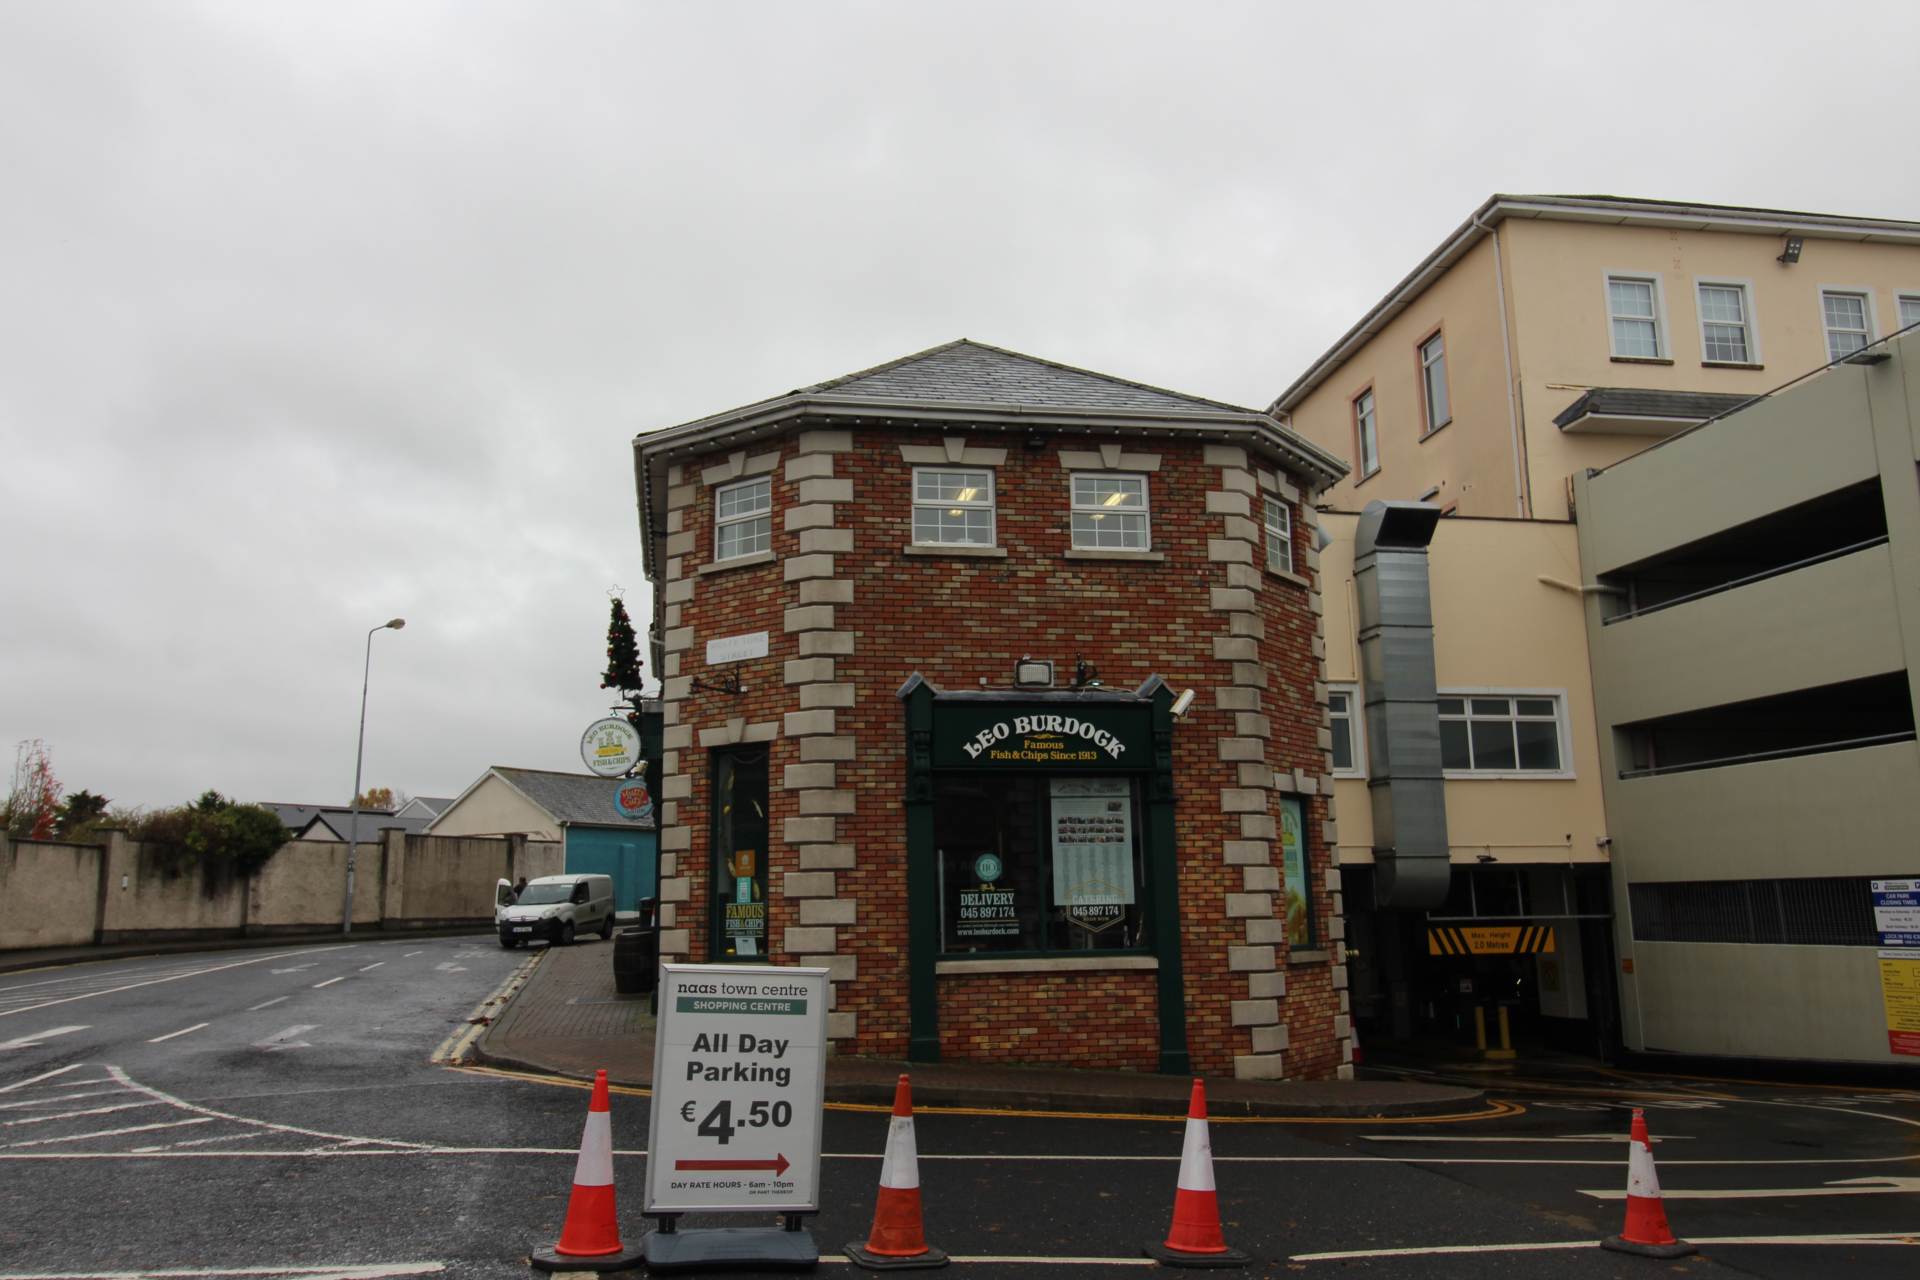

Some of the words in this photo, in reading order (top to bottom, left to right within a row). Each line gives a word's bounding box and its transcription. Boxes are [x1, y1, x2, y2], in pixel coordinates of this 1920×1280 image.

[963, 722, 1010, 759] LEO
[1013, 715, 1126, 760] BURDOCK
[1024, 740, 1065, 750] Famous
[1050, 750, 1077, 760] Since
[1078, 751, 1098, 760] 1913
[960, 893, 1015, 906] DELIVERY
[726, 904, 764, 918] FAMOUS
[960, 907, 979, 919] 045
[980, 907, 998, 919] 897
[999, 906, 1016, 918] 174
[1072, 906, 1088, 916] 045
[1089, 906, 1104, 916] 897
[1105, 906, 1119, 916] 174
[677, 984, 718, 995] naas
[721, 983, 758, 996] town
[761, 984, 809, 997] centre
[693, 1000, 748, 1011] SHOPPING
[750, 1002, 791, 1012] CENTRE
[691, 1033, 729, 1053] All
[738, 1033, 789, 1059] Day
[686, 1061, 791, 1087] Parking
[713, 1181, 742, 1189] HOURS
[748, 1181, 766, 1189] 6am
[773, 1181, 794, 1189] 10pm
